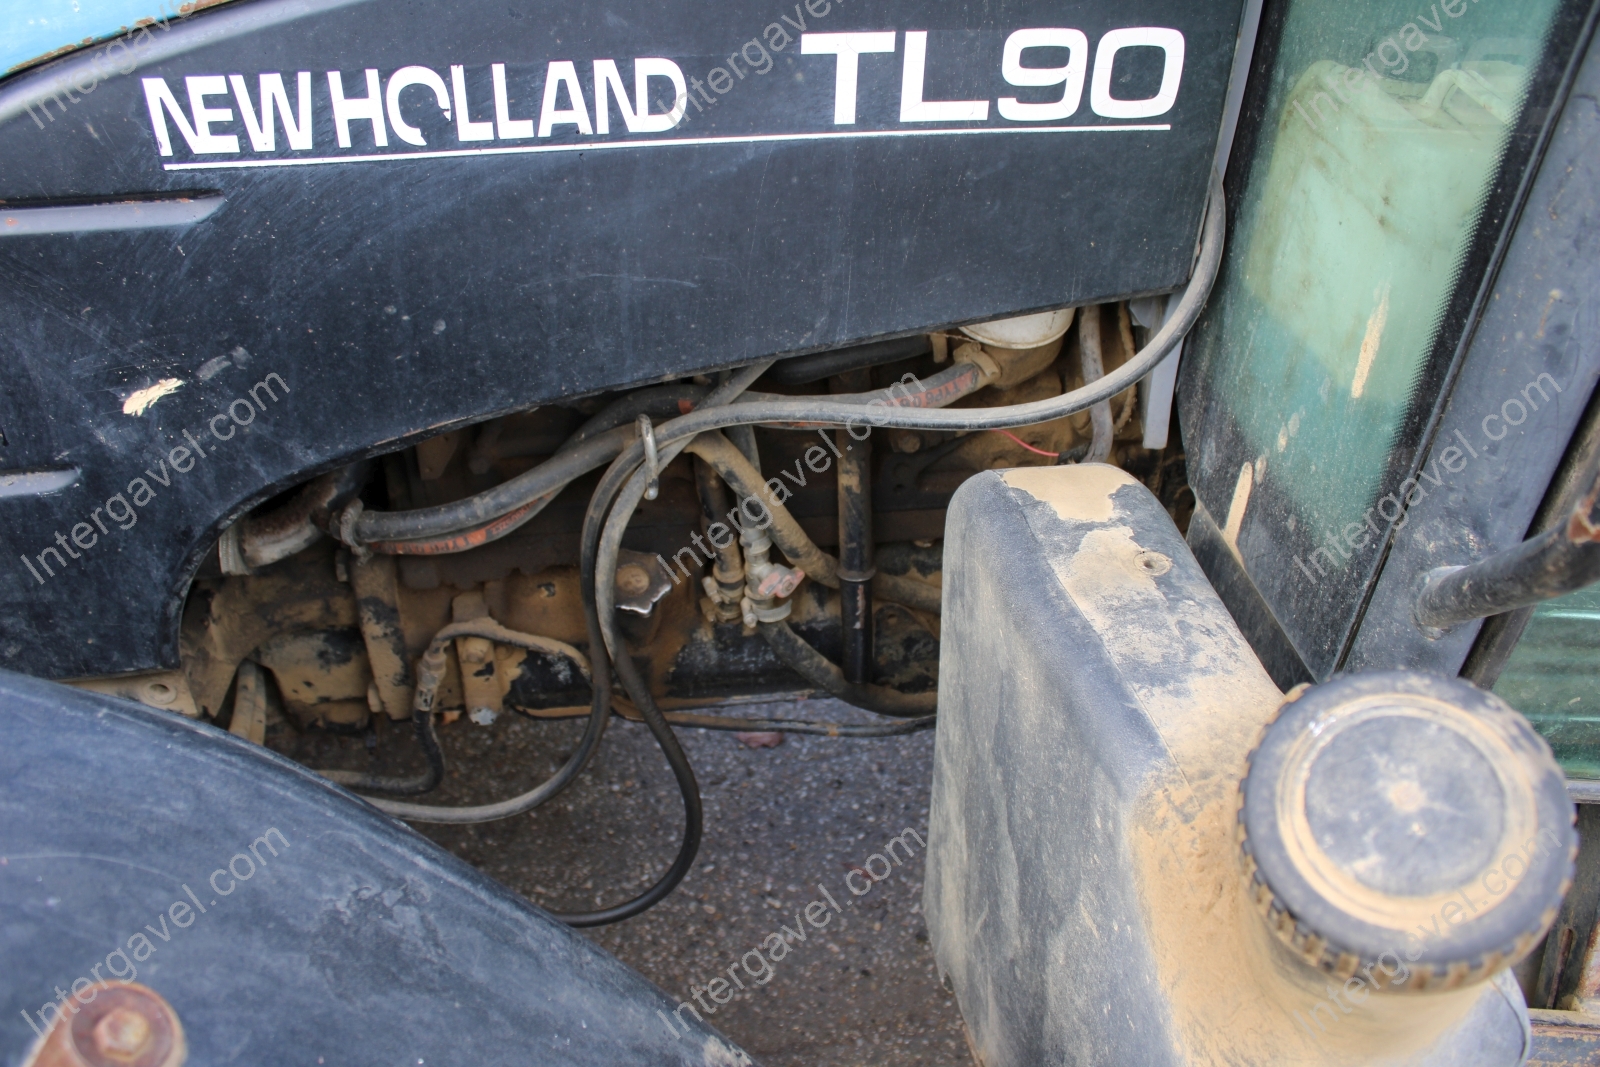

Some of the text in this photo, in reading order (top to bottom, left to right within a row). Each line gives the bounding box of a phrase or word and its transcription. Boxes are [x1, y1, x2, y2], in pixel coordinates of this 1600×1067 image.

[141, 57, 689, 157] NEW HOLLAND
[800, 26, 1186, 125] TL90
